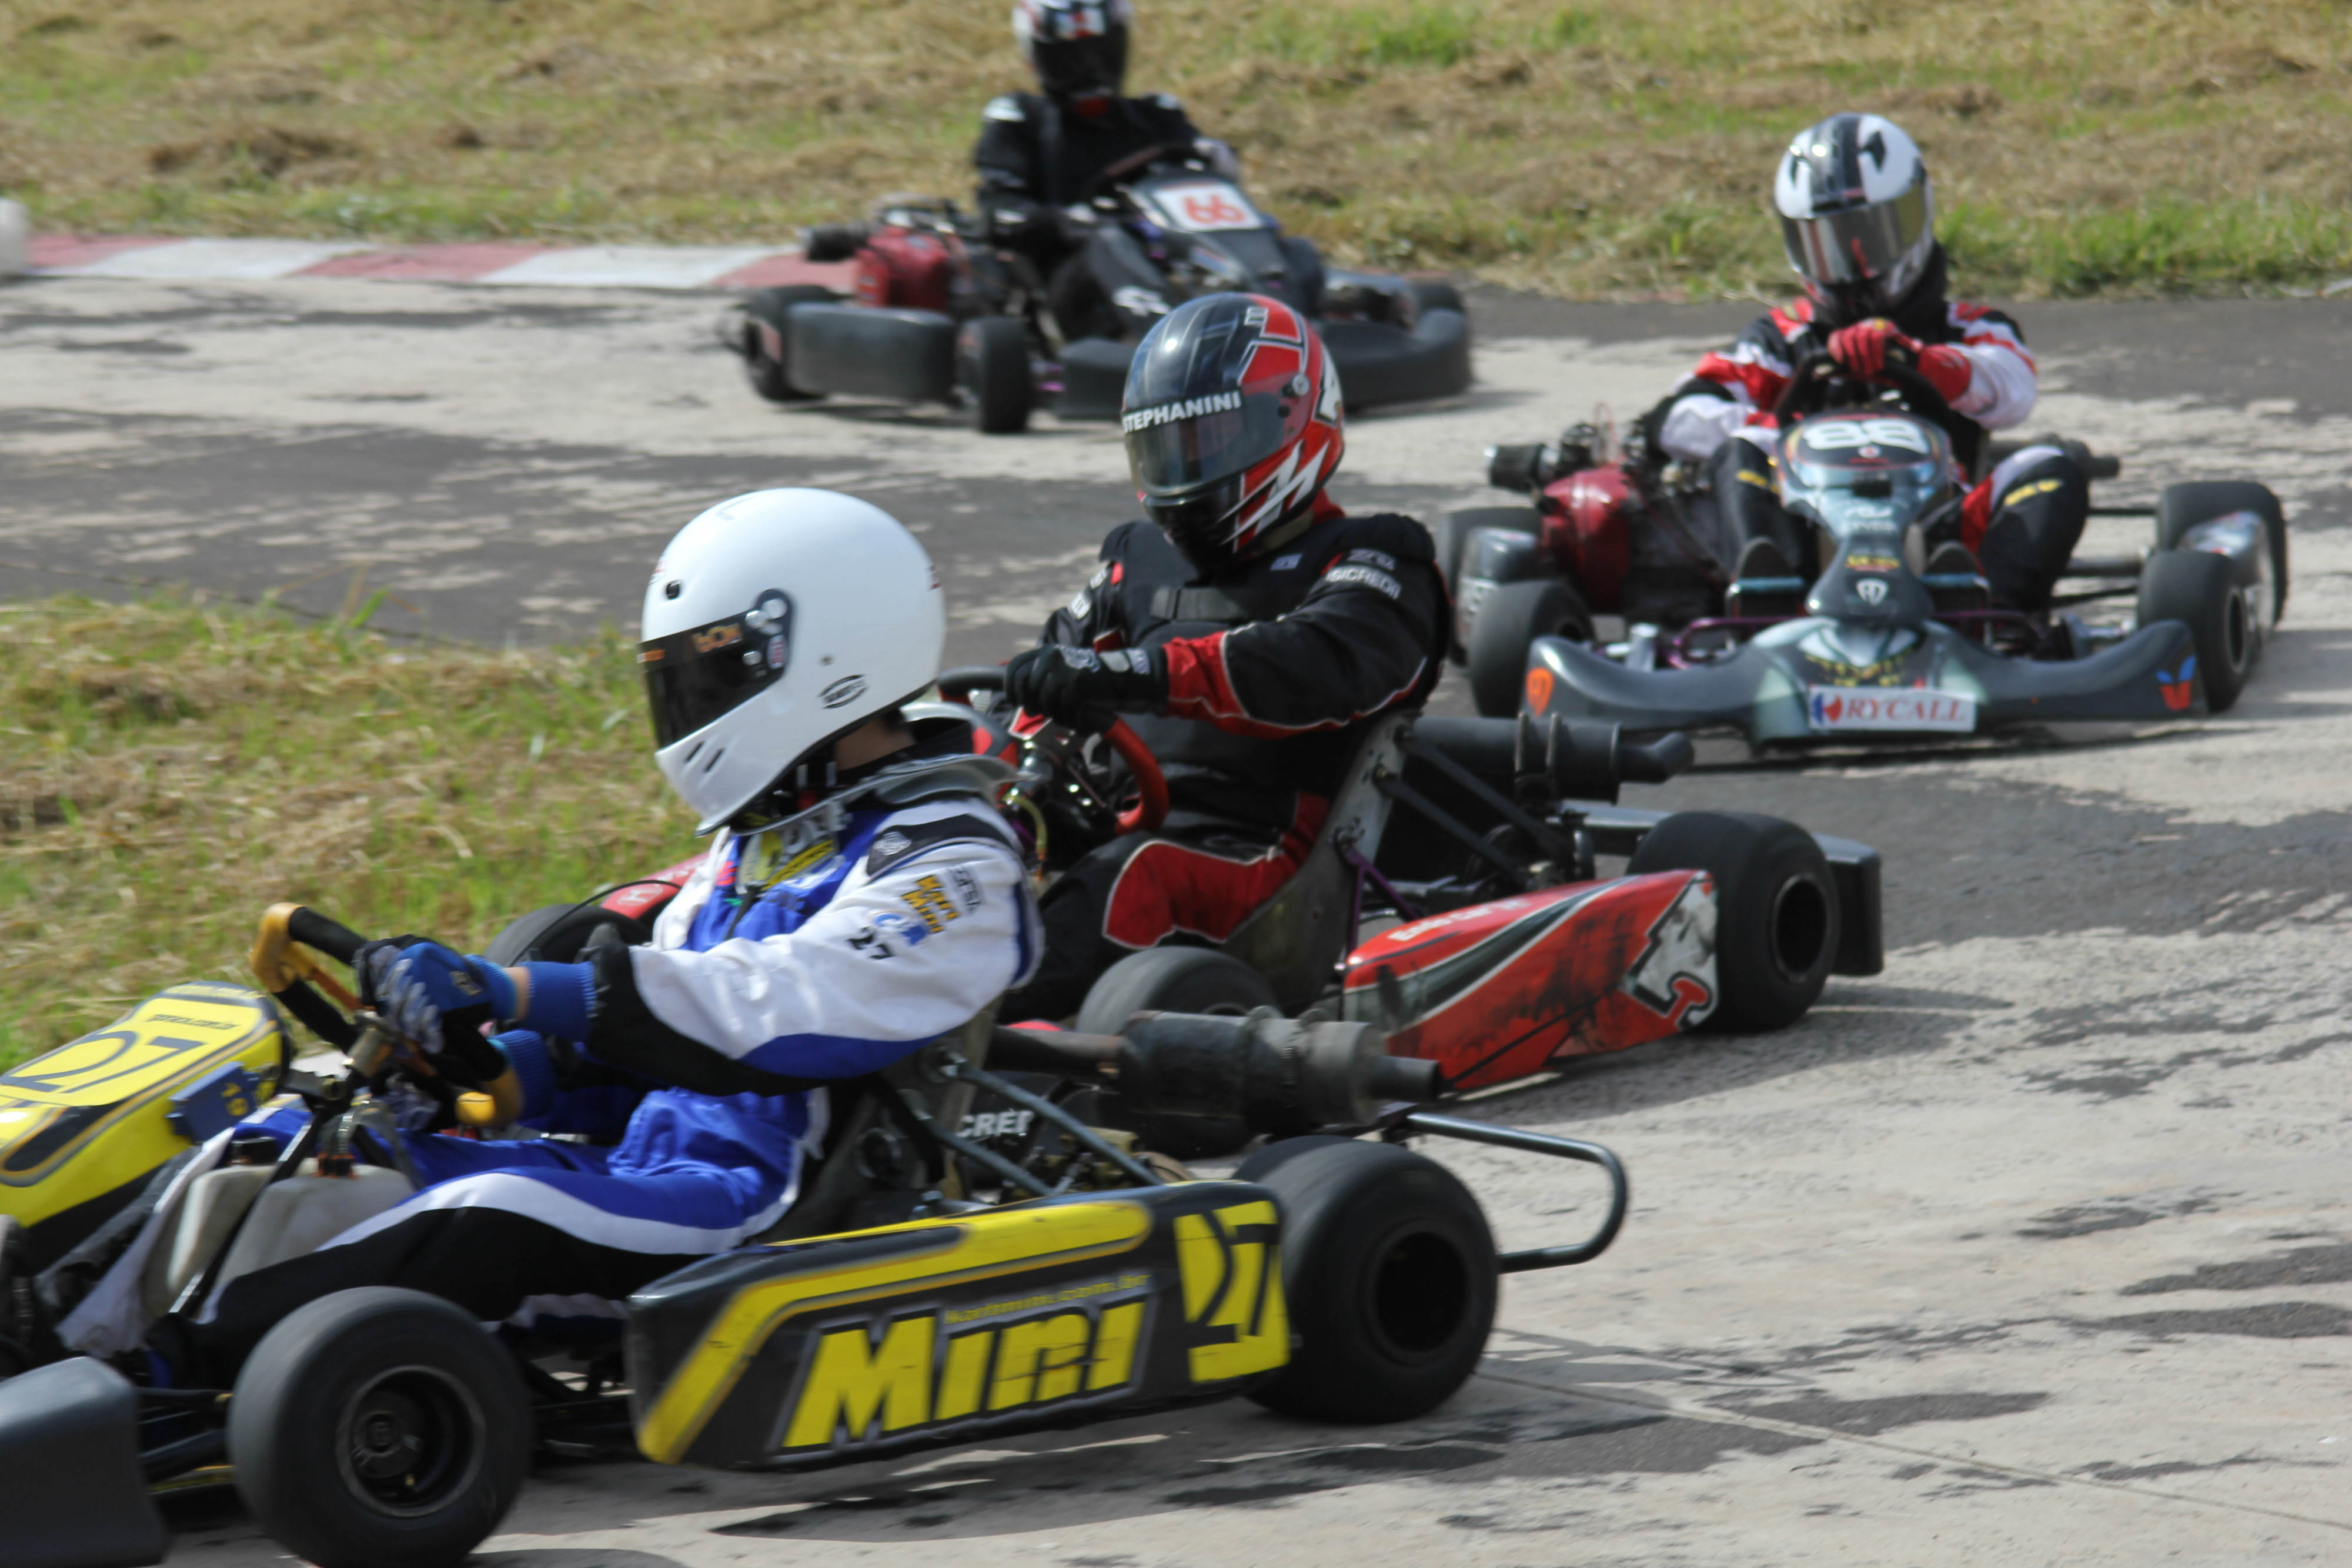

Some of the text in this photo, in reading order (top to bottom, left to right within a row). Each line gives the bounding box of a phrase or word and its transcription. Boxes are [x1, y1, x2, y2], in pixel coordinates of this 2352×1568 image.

[1184, 195, 1245, 223] 66
[1122, 390, 1243, 434] STEPHANINI
[1803, 418, 1930, 455] 88
[1847, 697, 1967, 721] RYCALL
[0, 1031, 207, 1094] 27
